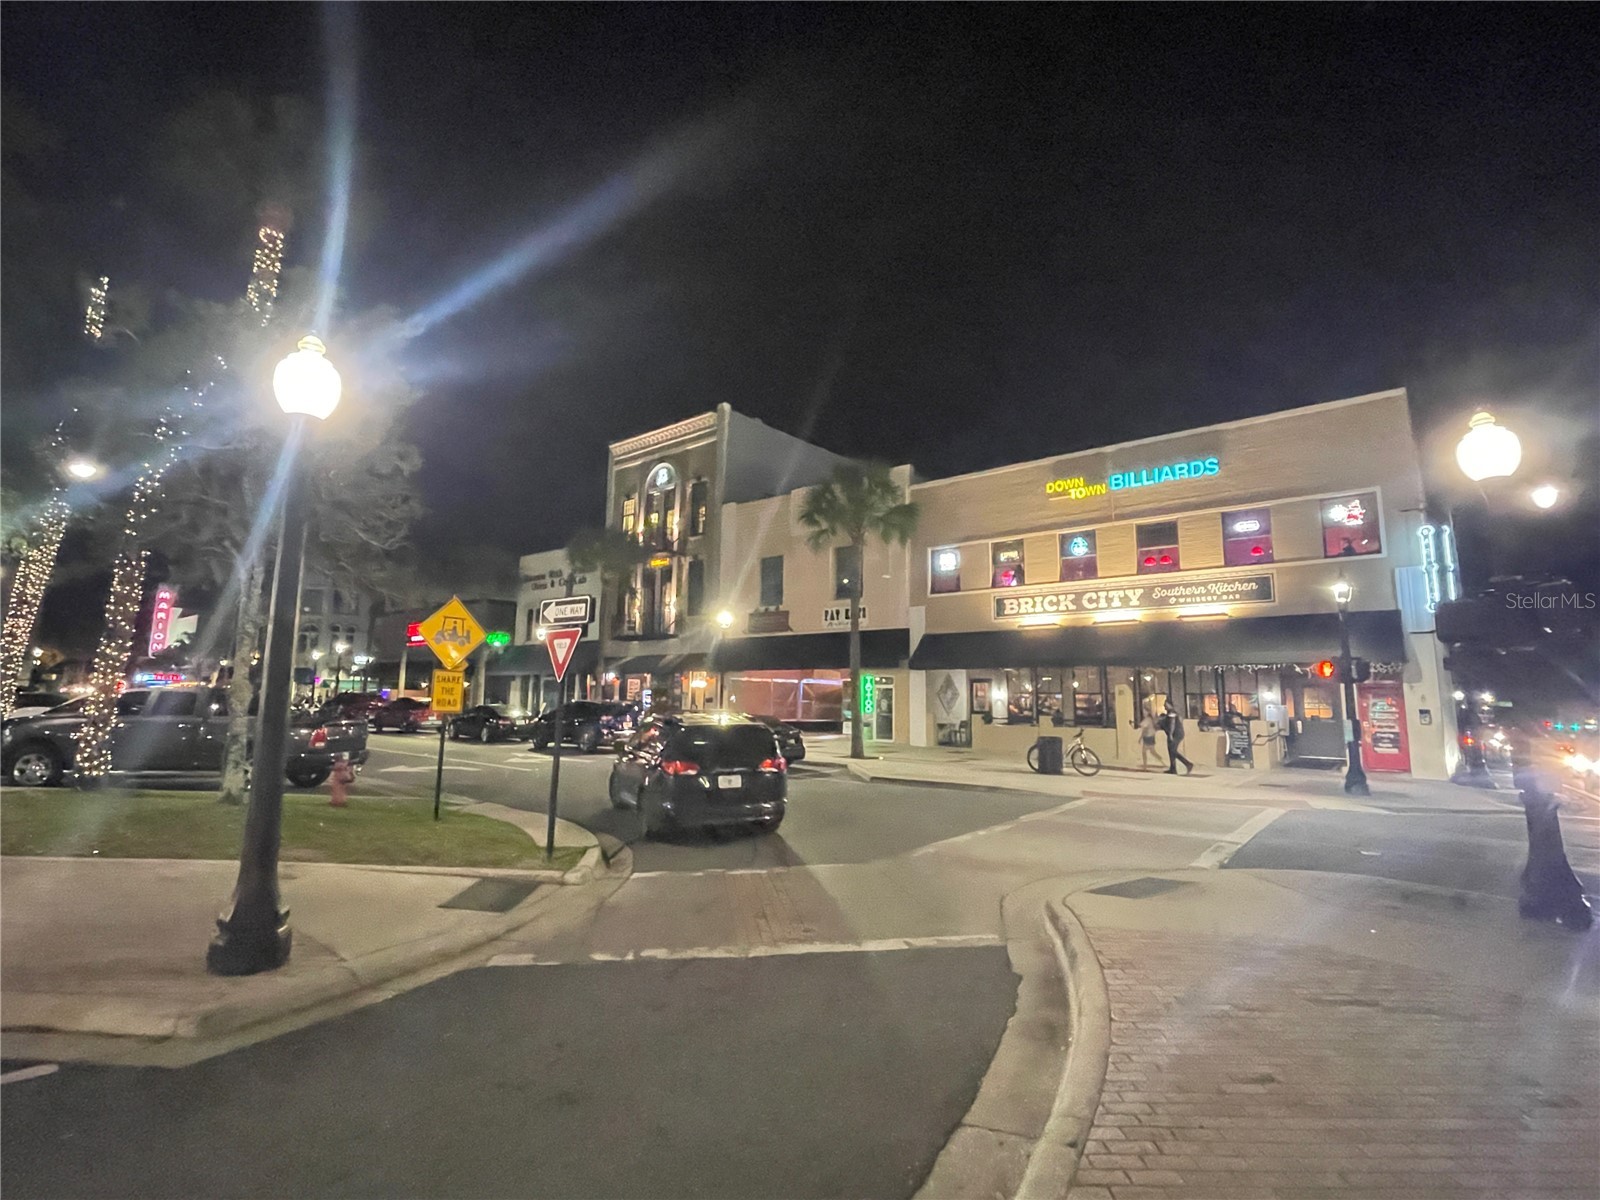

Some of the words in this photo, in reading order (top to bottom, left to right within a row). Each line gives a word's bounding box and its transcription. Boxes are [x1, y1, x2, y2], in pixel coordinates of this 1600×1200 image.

[1046, 477, 1084, 494] DOWN
[1068, 483, 1107, 500] TOWN
[1109, 456, 1220, 491] BILLIARDS
[1152, 585, 1207, 599] Southern
[1207, 581, 1259, 595] Kitchen
[1003, 593, 1077, 615] BRICK
[1082, 588, 1145, 609] CITY
[555, 606, 568, 617] ONE
[570, 605, 583, 615] WAY
[152, 591, 170, 650] MARION
[436, 675, 462, 684] SHARE
[441, 687, 455, 696] THE
[436, 698, 458, 707] ROAD
